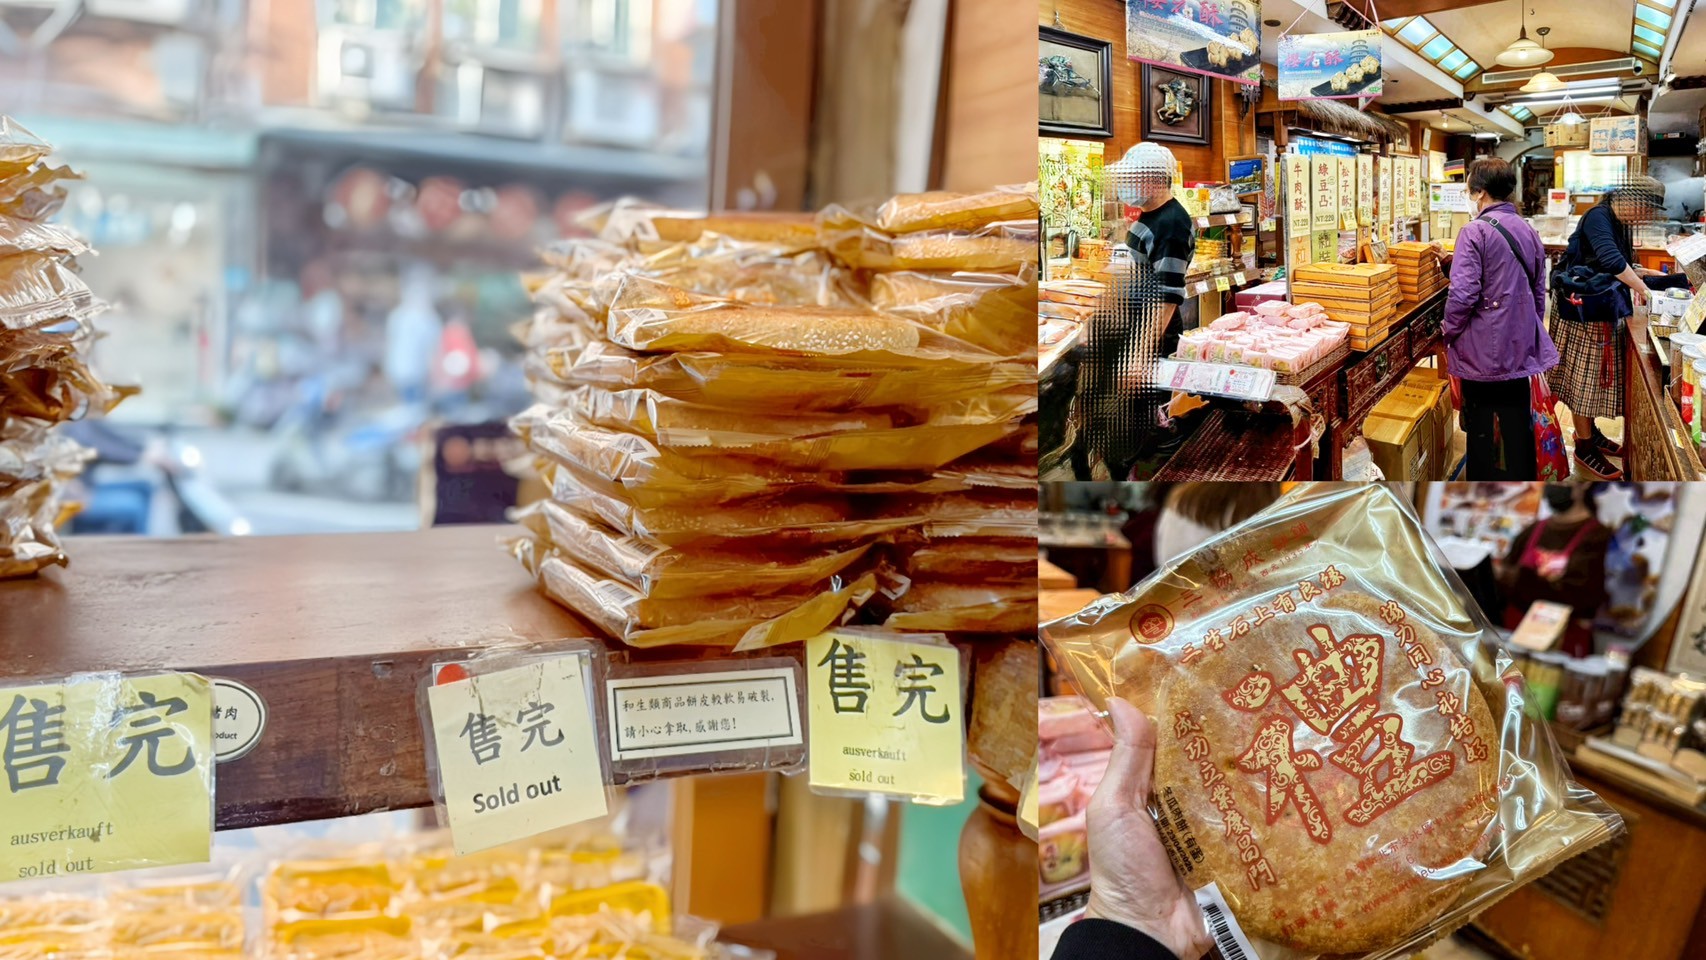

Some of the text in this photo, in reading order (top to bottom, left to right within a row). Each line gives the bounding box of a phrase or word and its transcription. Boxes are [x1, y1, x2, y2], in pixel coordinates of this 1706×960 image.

[1294, 162, 1303, 212] 牛肉酥
[1318, 163, 1328, 207] 綠豆凸
[817, 638, 950, 724] 售完
[0, 691, 196, 793] 售完
[459, 701, 564, 765] 售完
[842, 745, 907, 761] ausverkauft
[472, 775, 562, 814] Sold out
[849, 770, 896, 785] sold out
[10, 821, 114, 846] ausverkauft
[18, 856, 95, 879] sold out
